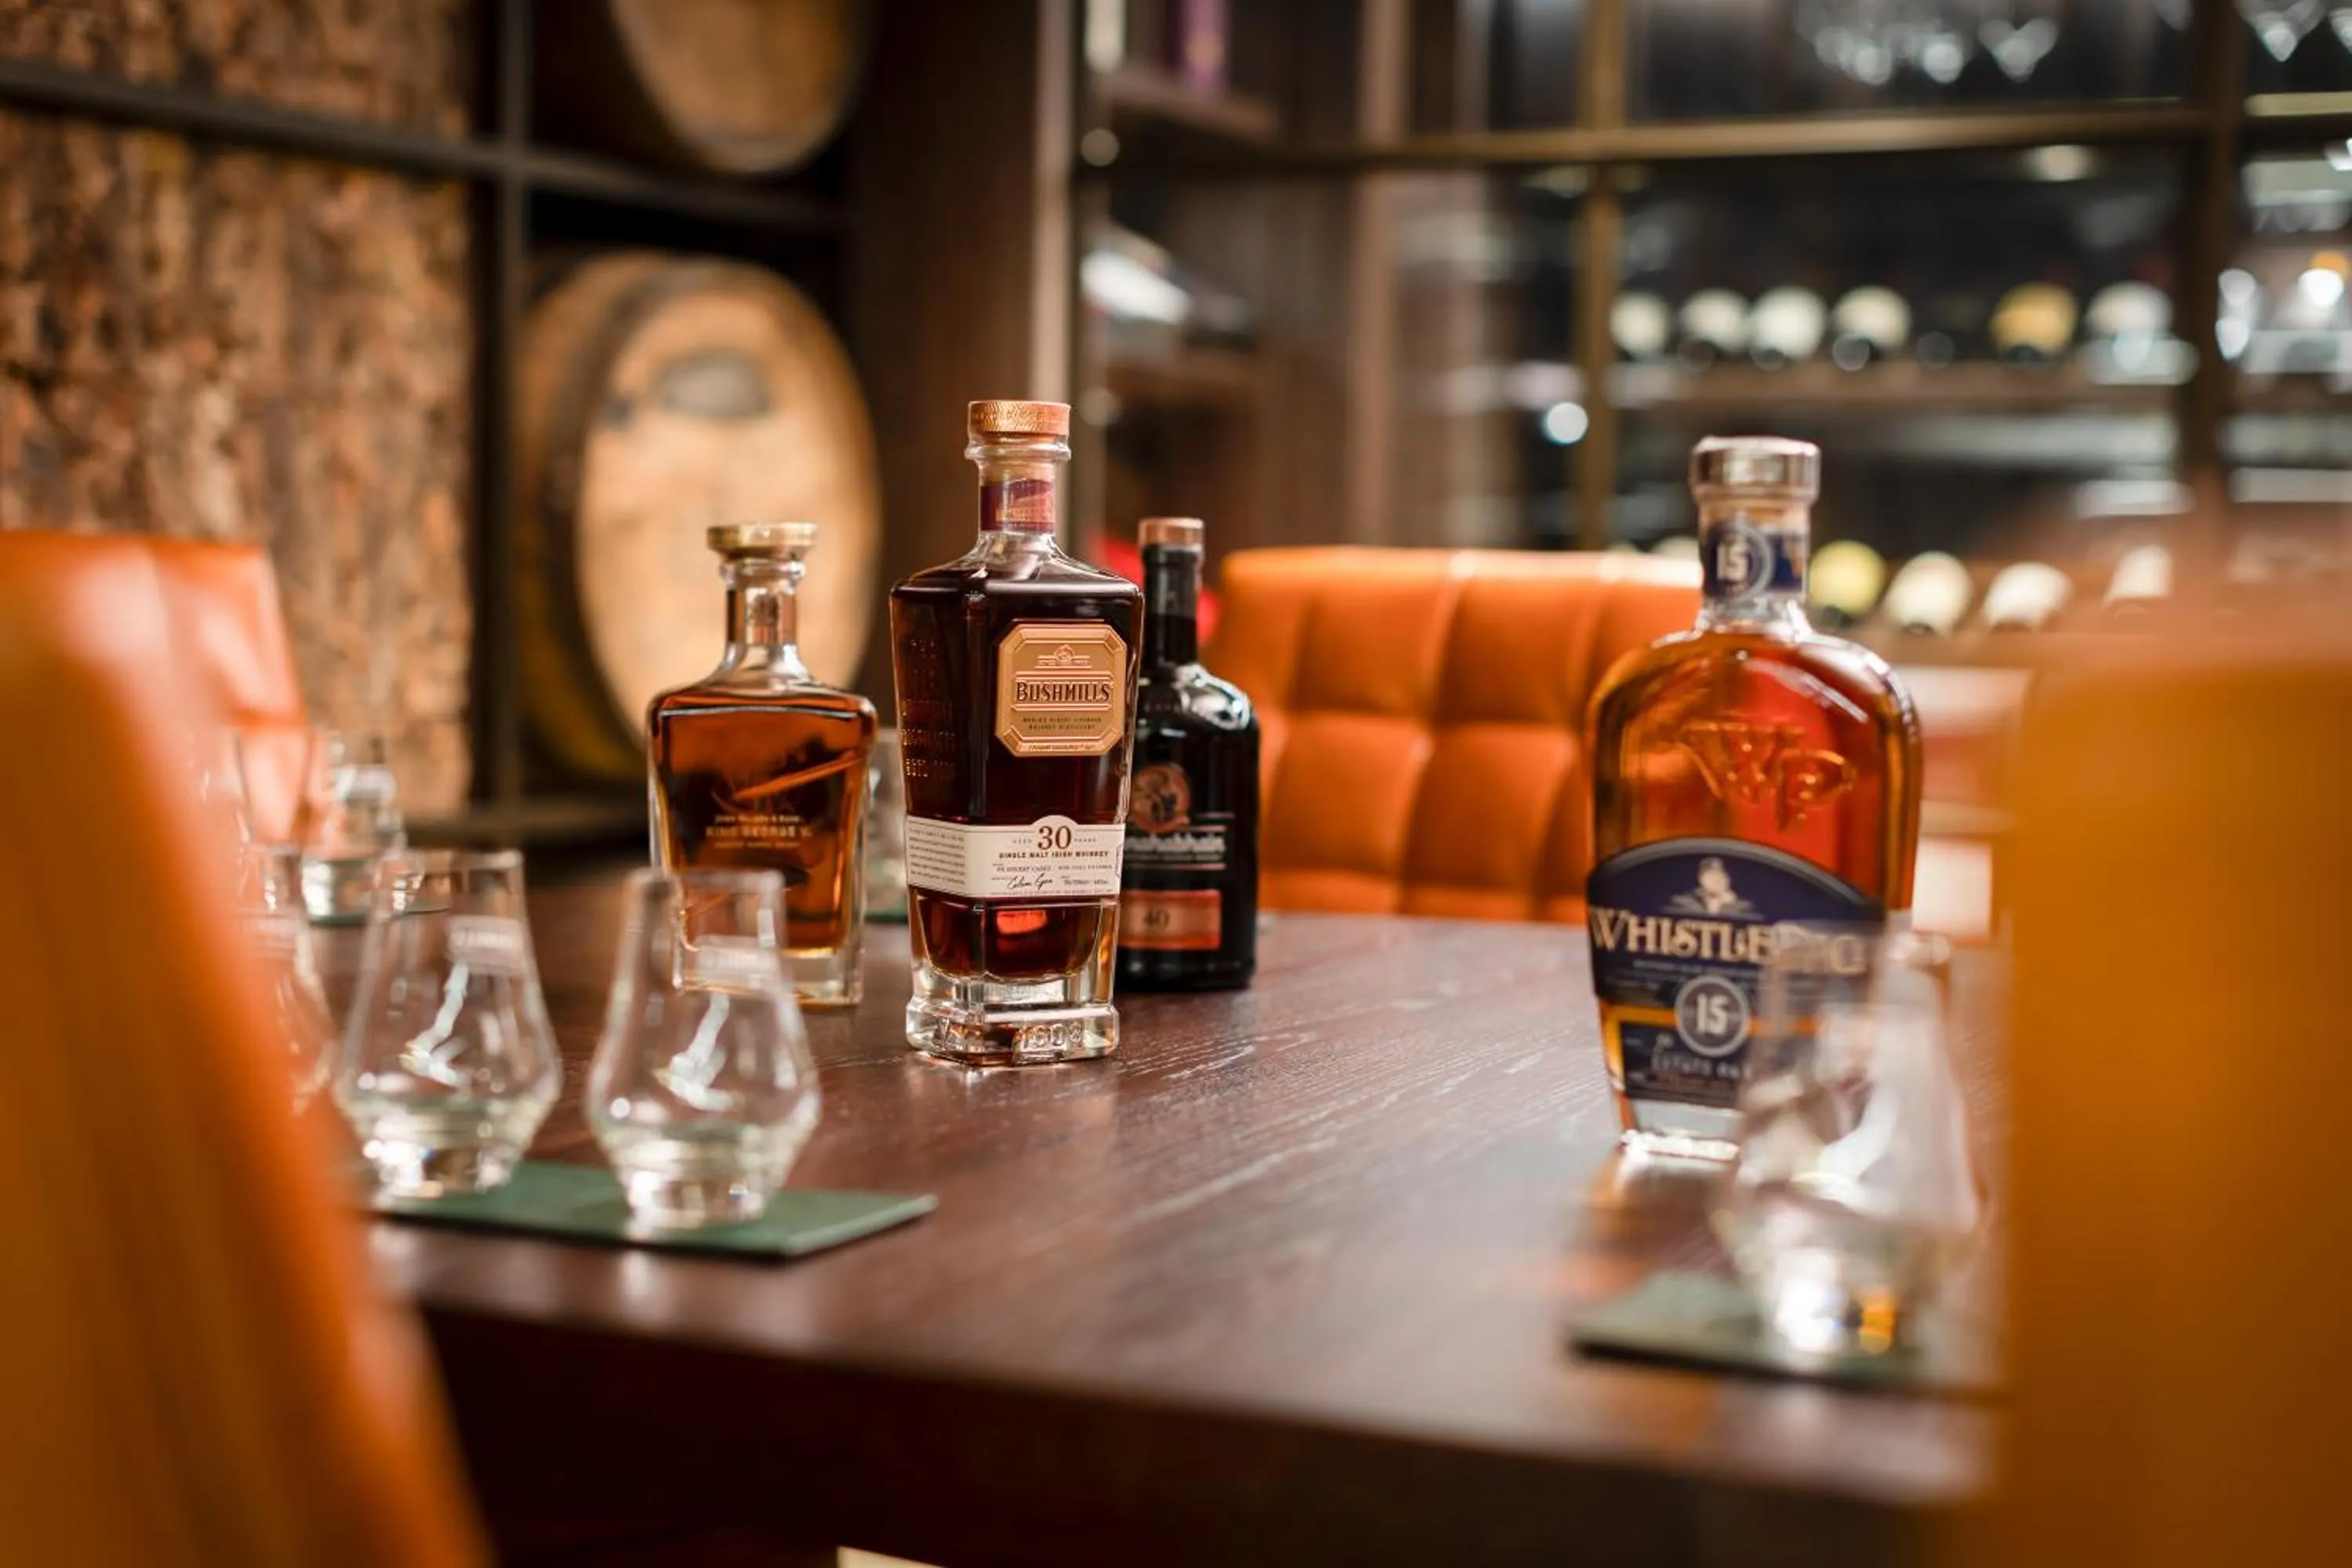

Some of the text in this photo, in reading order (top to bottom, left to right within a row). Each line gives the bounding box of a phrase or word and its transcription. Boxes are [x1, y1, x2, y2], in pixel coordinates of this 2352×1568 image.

[1717, 542, 1748, 581] 15
[1016, 682, 1110, 702] BUSHMILLS
[1037, 826, 1072, 850] 30
[1144, 908, 1169, 927] 40
[1697, 993, 1729, 1035] 15
